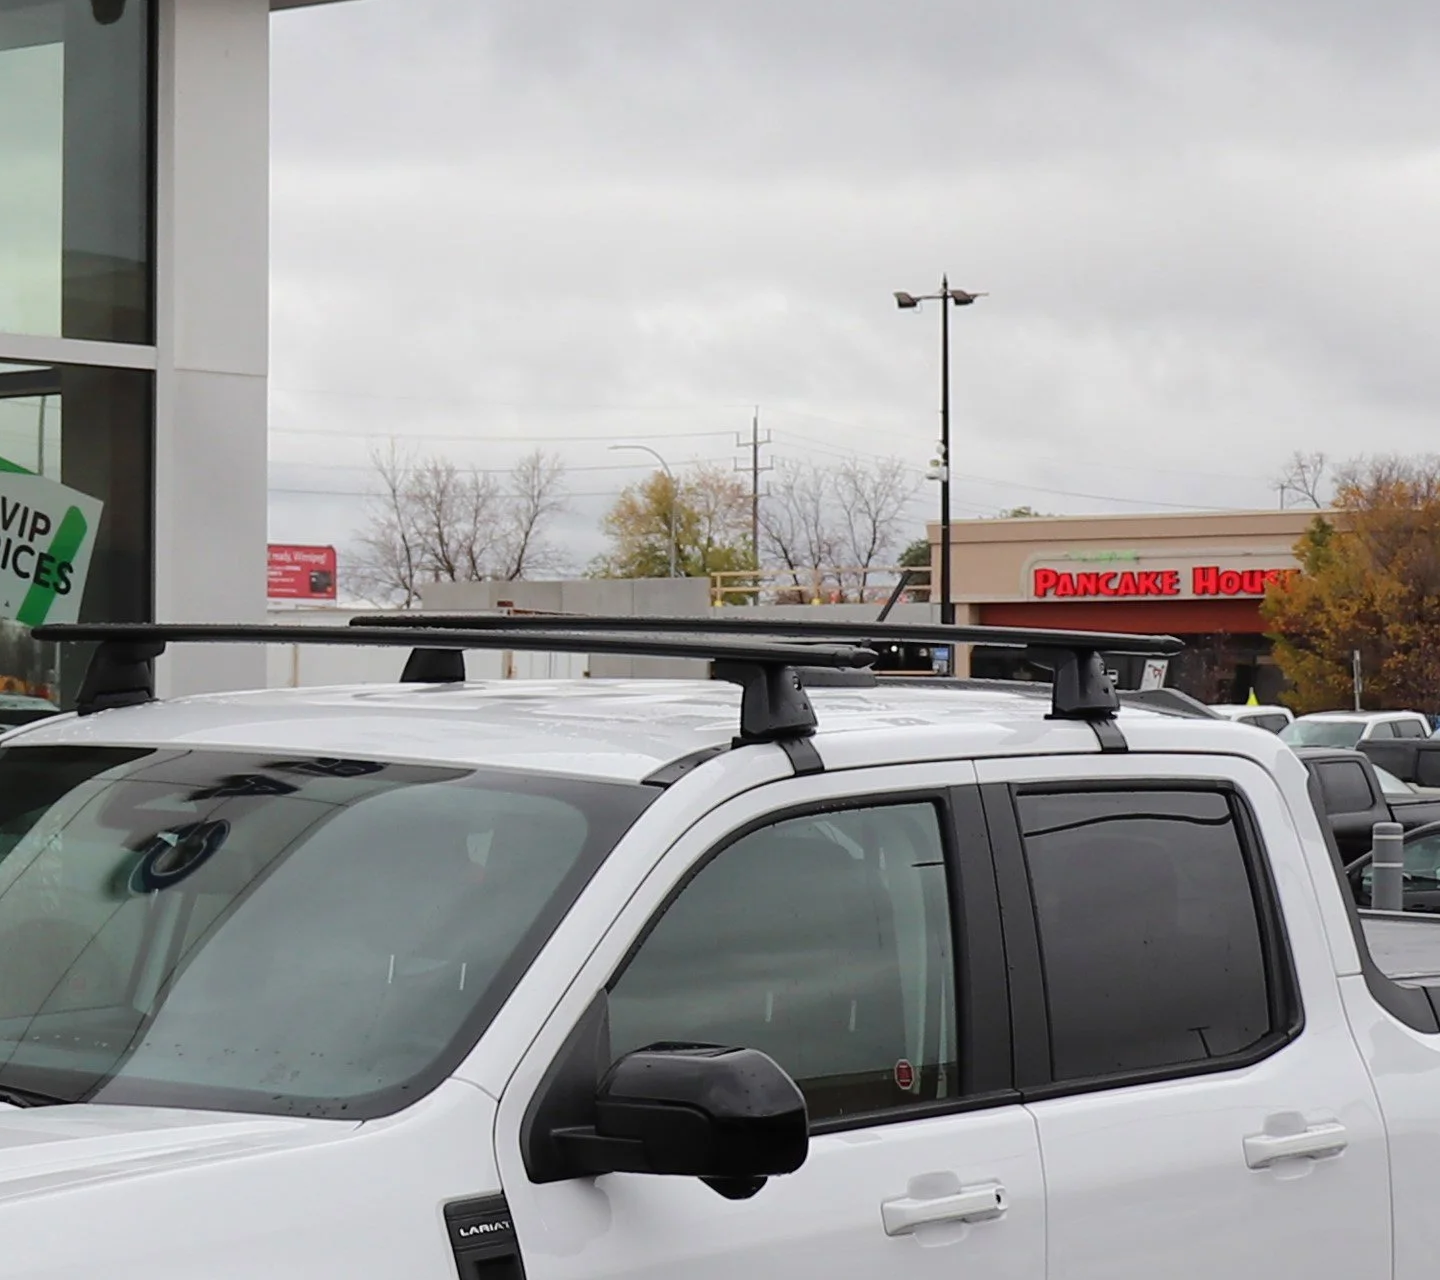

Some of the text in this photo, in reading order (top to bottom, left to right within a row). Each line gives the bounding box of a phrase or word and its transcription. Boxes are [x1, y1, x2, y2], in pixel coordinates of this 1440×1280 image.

[0, 496, 52, 543] VIP
[1034, 568, 1180, 597] PANCAKE
[459, 1220, 511, 1237] LARIAT
